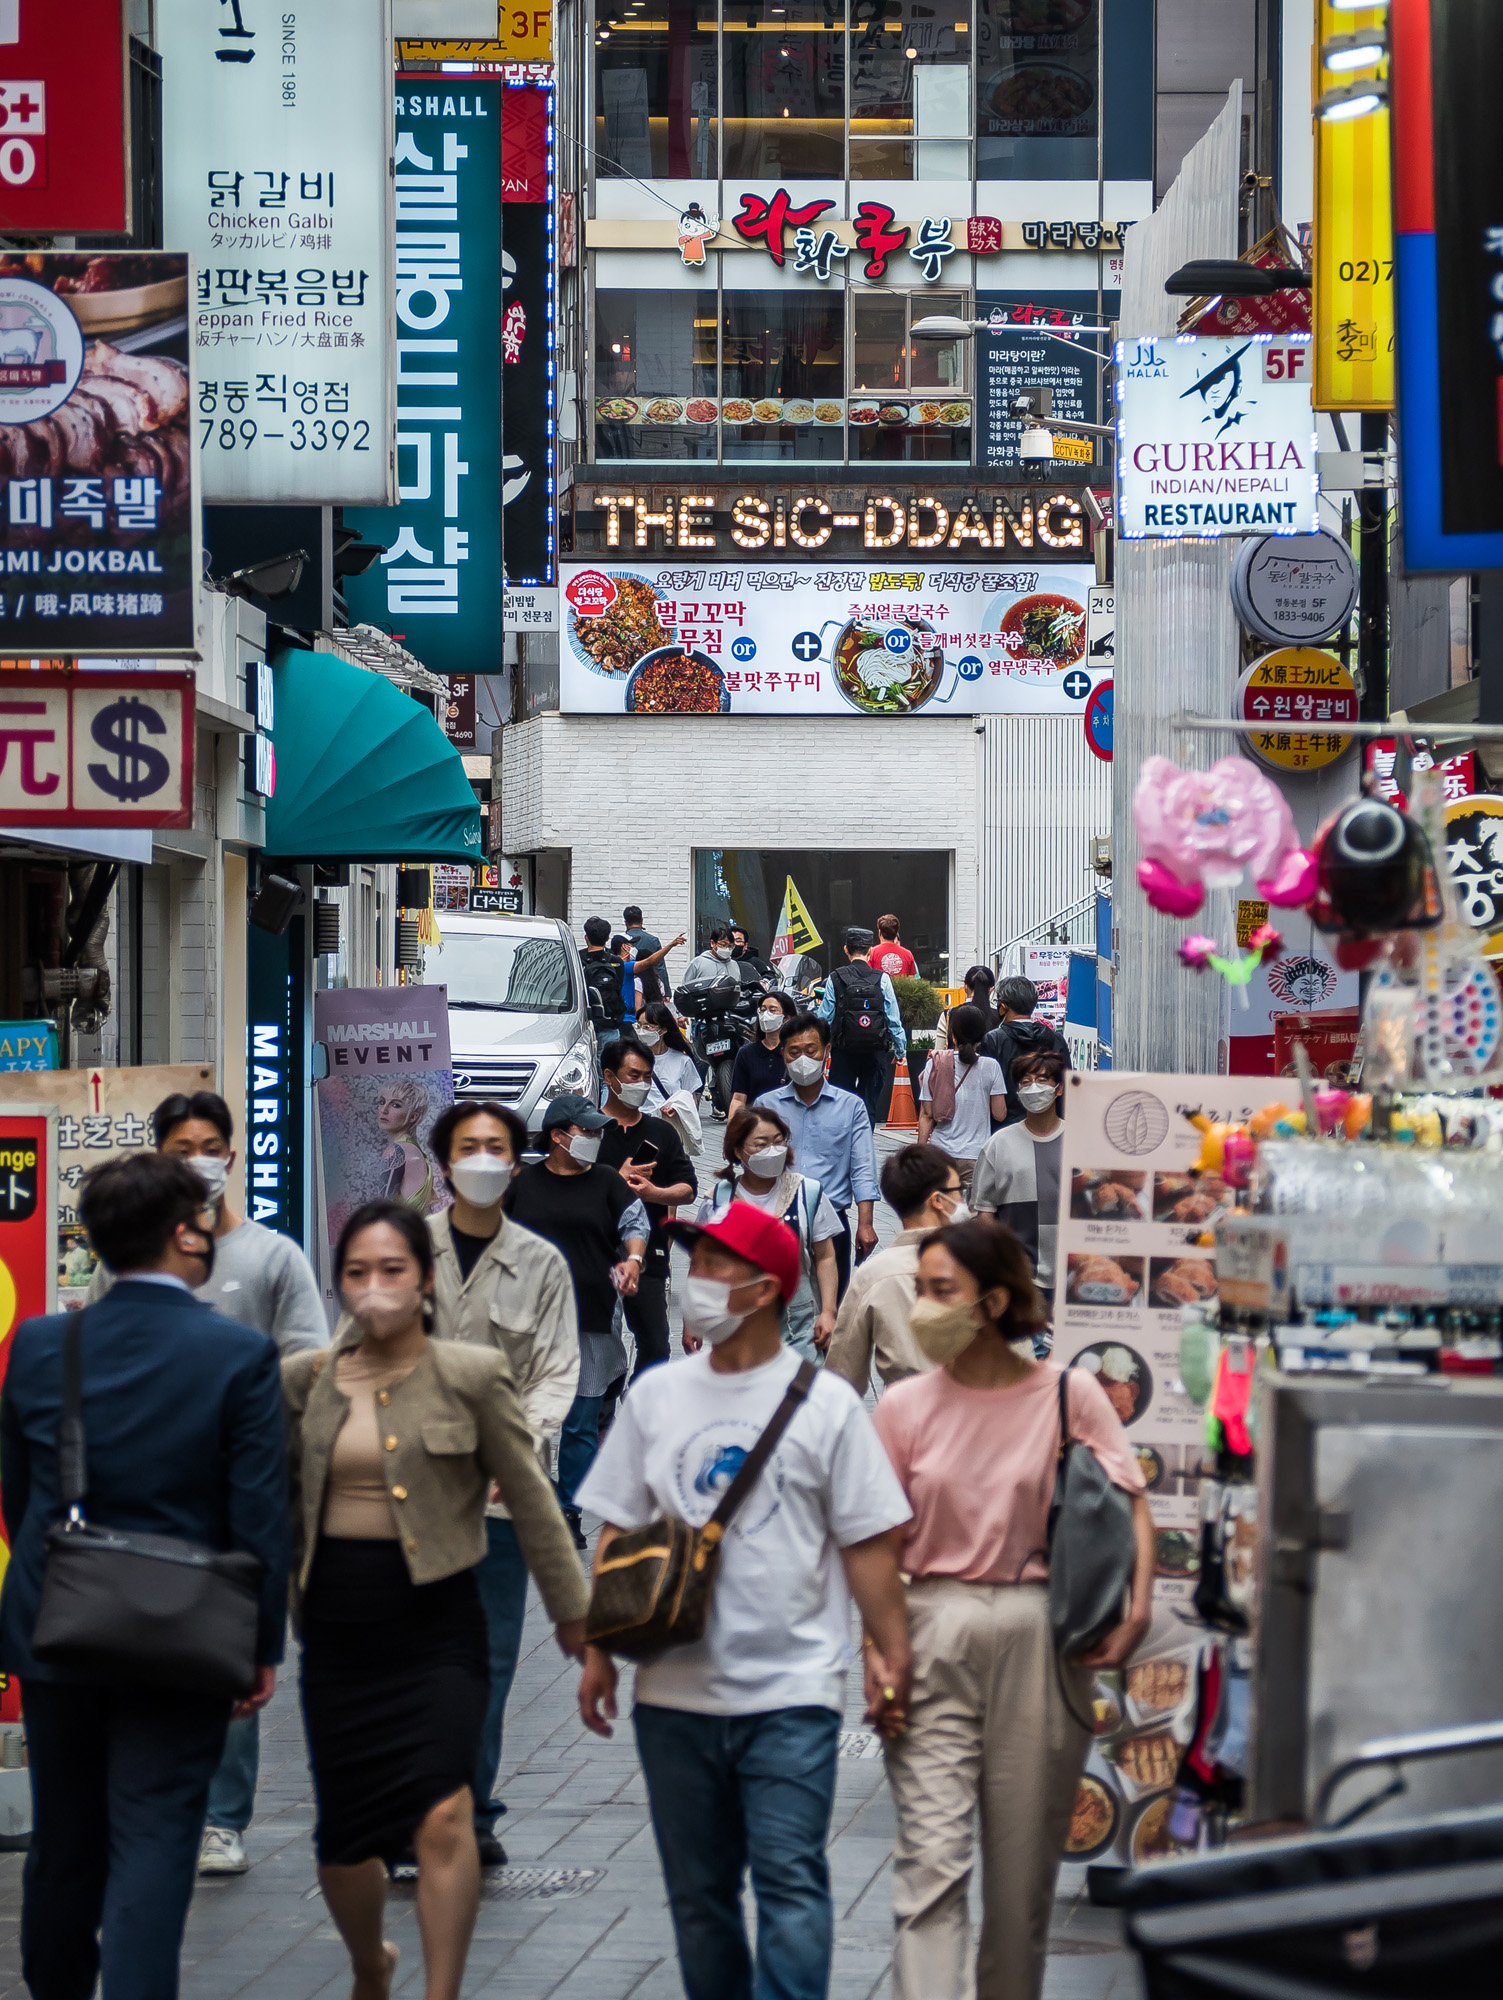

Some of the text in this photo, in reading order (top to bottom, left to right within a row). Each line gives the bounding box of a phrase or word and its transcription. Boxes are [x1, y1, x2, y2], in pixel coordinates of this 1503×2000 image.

[511, 11, 551, 38] 3F
[281, 13, 296, 108] SINCE 1981
[208, 170, 334, 208] 닭갈비
[208, 212, 334, 229] Chicken Galbi
[262, 311, 306, 327] Fried
[314, 311, 353, 327] Rice
[989, 350, 1046, 362] 마라탕이란?
[1265, 347, 1306, 380] 5F
[1061, 366, 1080, 375] 이라는
[1127, 368, 1169, 379] HALAL
[199, 418, 370, 451] 789-3392
[1054, 444, 1073, 457] CCTV
[1133, 440, 1307, 473] GURKHA
[1151, 477, 1289, 495] INDIAN/NEPALI
[594, 494, 717, 547] THE
[1145, 502, 1297, 526] RESTAURANT
[0, 551, 163, 573] MI JOKBAL
[654, 570, 706, 591] 요렇게
[708, 571, 744, 592] 비벼
[813, 571, 867, 592] 진정한
[869, 572, 925, 592] 밥도둑!
[929, 572, 980, 593] 더식당
[656, 600, 748, 626] 벌교꼬막
[1312, 597, 1327, 608] 5F
[521, 610, 552, 623] 전문점
[1273, 610, 1326, 623] 1833-9406
[678, 629, 724, 655] 무침
[733, 640, 756, 656] or
[886, 635, 909, 650] or
[959, 660, 982, 676] or
[1260, 664, 1342, 686] 水原王カルビ
[452, 684, 470, 697] 3F
[1252, 694, 1351, 721] 수원왕갈비
[1092, 712, 1114, 730] 주차
[1260, 731, 1343, 753] 水原王牛排
[1293, 754, 1310, 767] 3F
[473, 895, 520, 911] 더식당
[327, 1021, 437, 1043] MARSHALL
[335, 1044, 433, 1066] EVENT
[253, 1025, 280, 1234] MARSHA
